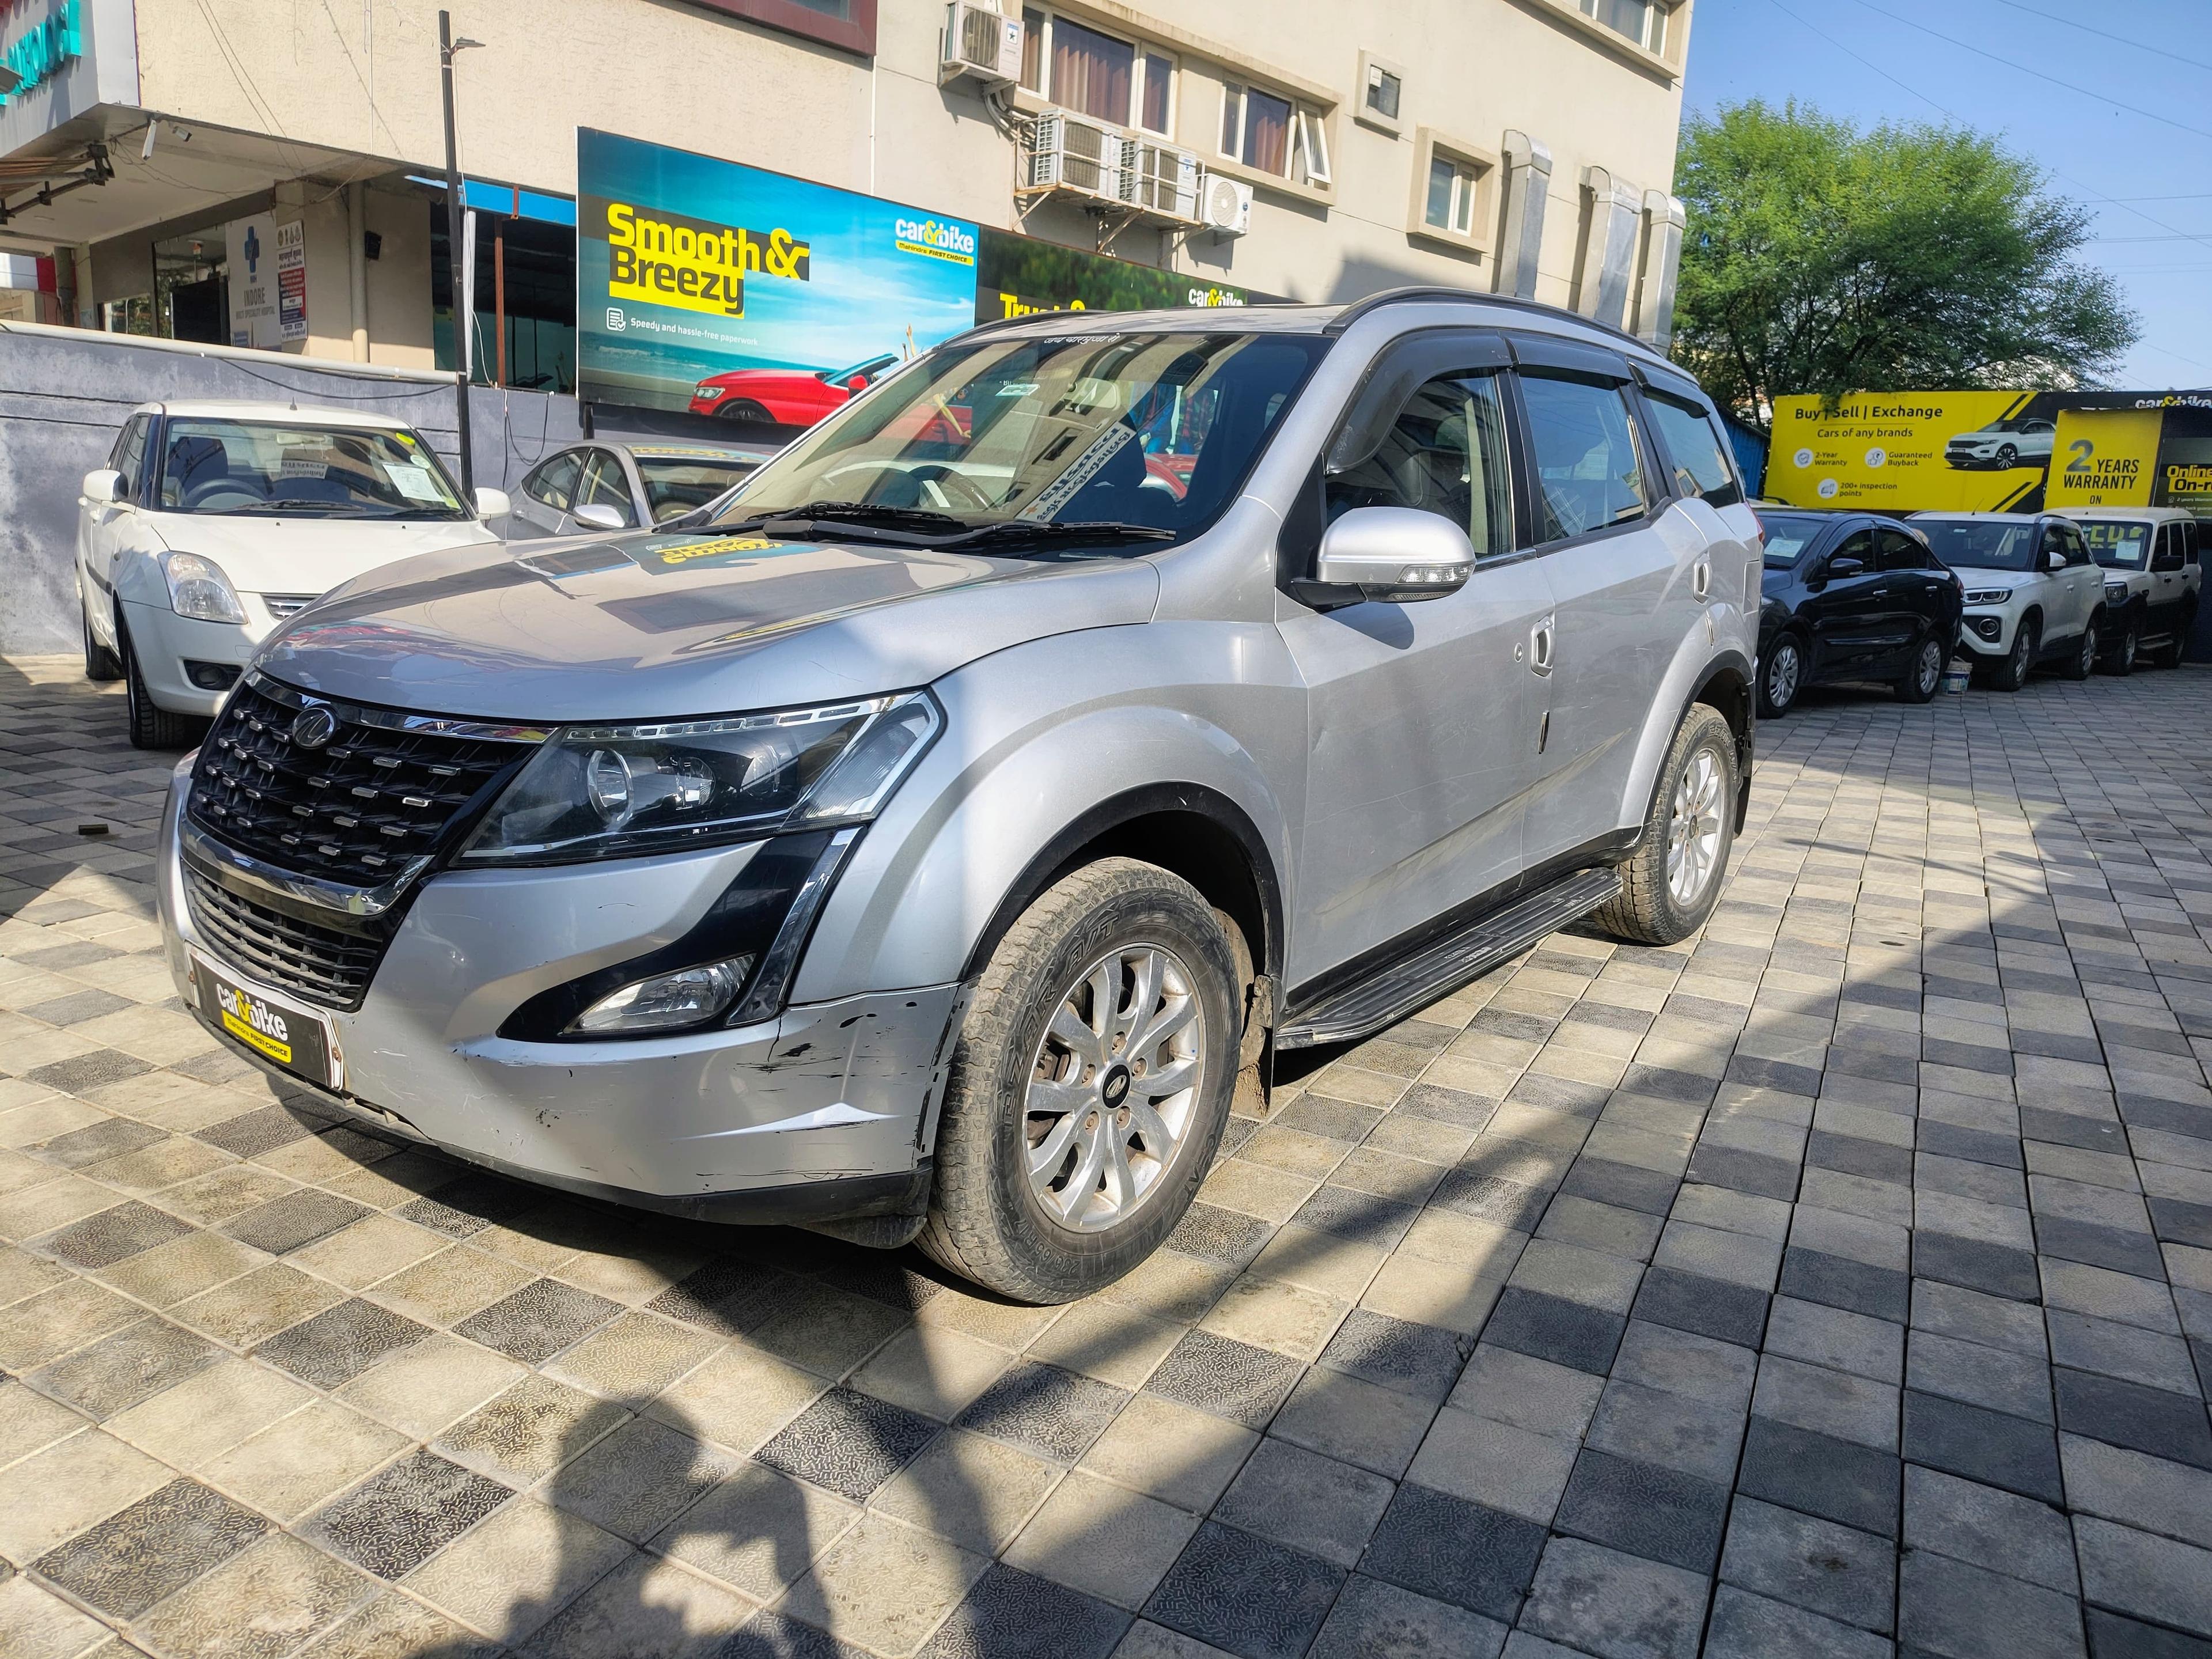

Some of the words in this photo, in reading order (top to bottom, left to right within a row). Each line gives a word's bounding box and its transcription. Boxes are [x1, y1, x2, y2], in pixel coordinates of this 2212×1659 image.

[607, 203, 760, 272] Smooth
[765, 228, 810, 280] &
[895, 218, 974, 253] car&bike
[929, 249, 946, 258] FIRST
[946, 253, 968, 263] CHOICE
[609, 244, 745, 315] Breezy
[244, 287, 266, 307] INDORE
[630, 317, 660, 332] Speedy
[662, 324, 676, 332] and
[678, 325, 719, 340] hassle-free
[721, 334, 758, 346] paperwork
[1796, 408, 1820, 421] Buy
[1833, 406, 1859, 418] Sell
[1872, 406, 1942, 419] Exchange
[1817, 429, 1839, 437] Cars
[1842, 428, 1854, 437] of
[1855, 430, 1874, 438] any
[1877, 428, 1912, 437] brands
[2066, 439, 2094, 472] 2
[2097, 459, 2139, 473] YEARS
[2064, 474, 2137, 489] WARRANTY
[2175, 479, 2212, 491] On-r
[2089, 495, 2101, 505] ON
[216, 983, 288, 1041] car&bike
[251, 1032, 266, 1046] FIRST
[266, 1041, 288, 1057] CHOICE
